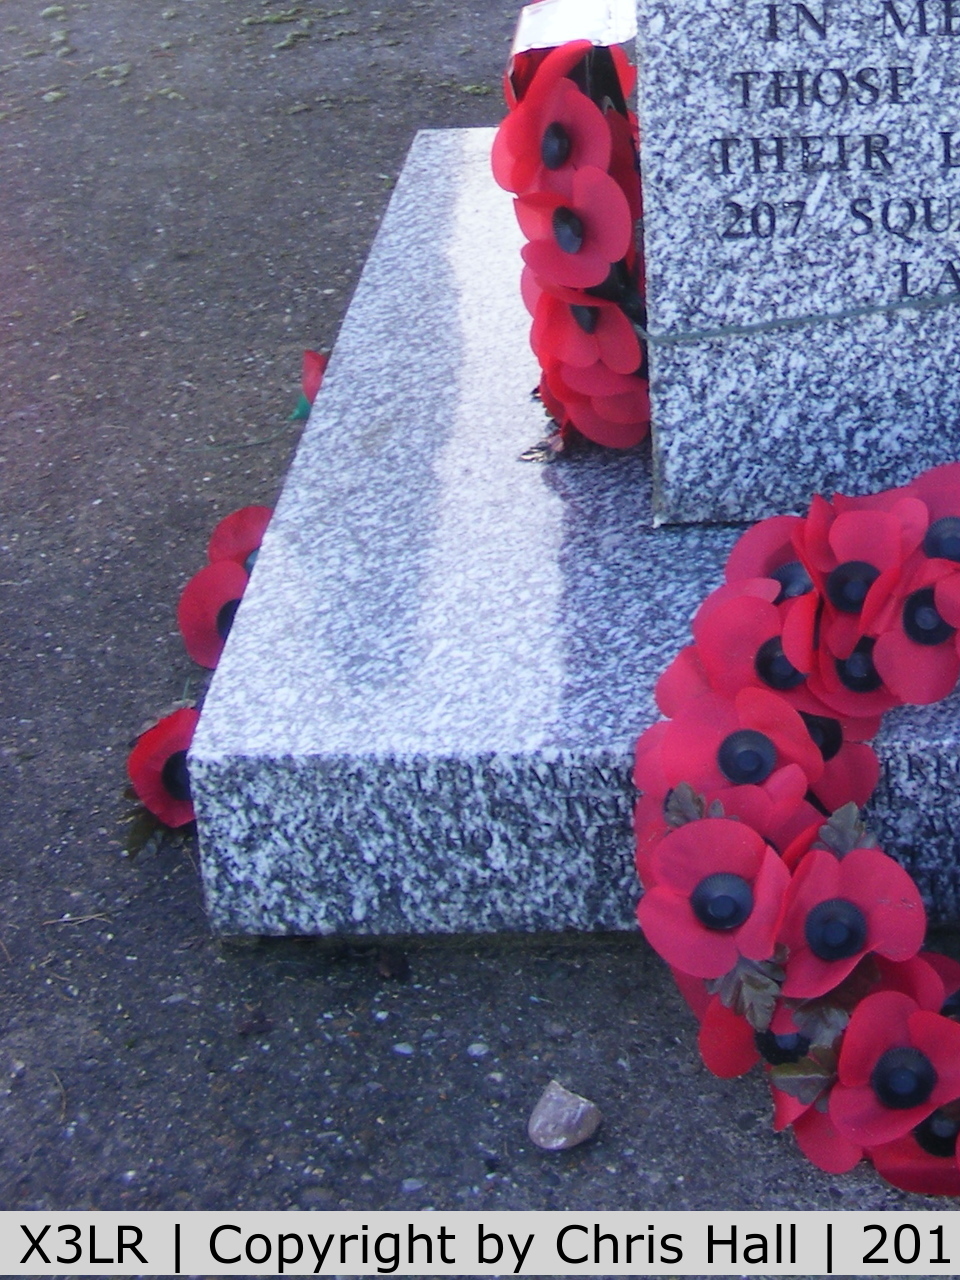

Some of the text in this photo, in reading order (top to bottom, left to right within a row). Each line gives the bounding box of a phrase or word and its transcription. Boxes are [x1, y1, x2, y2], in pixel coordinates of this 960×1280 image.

[763, 3, 830, 41] IN
[731, 66, 921, 109] THOSE
[709, 133, 894, 176] THEIR
[719, 201, 807, 240] 207
